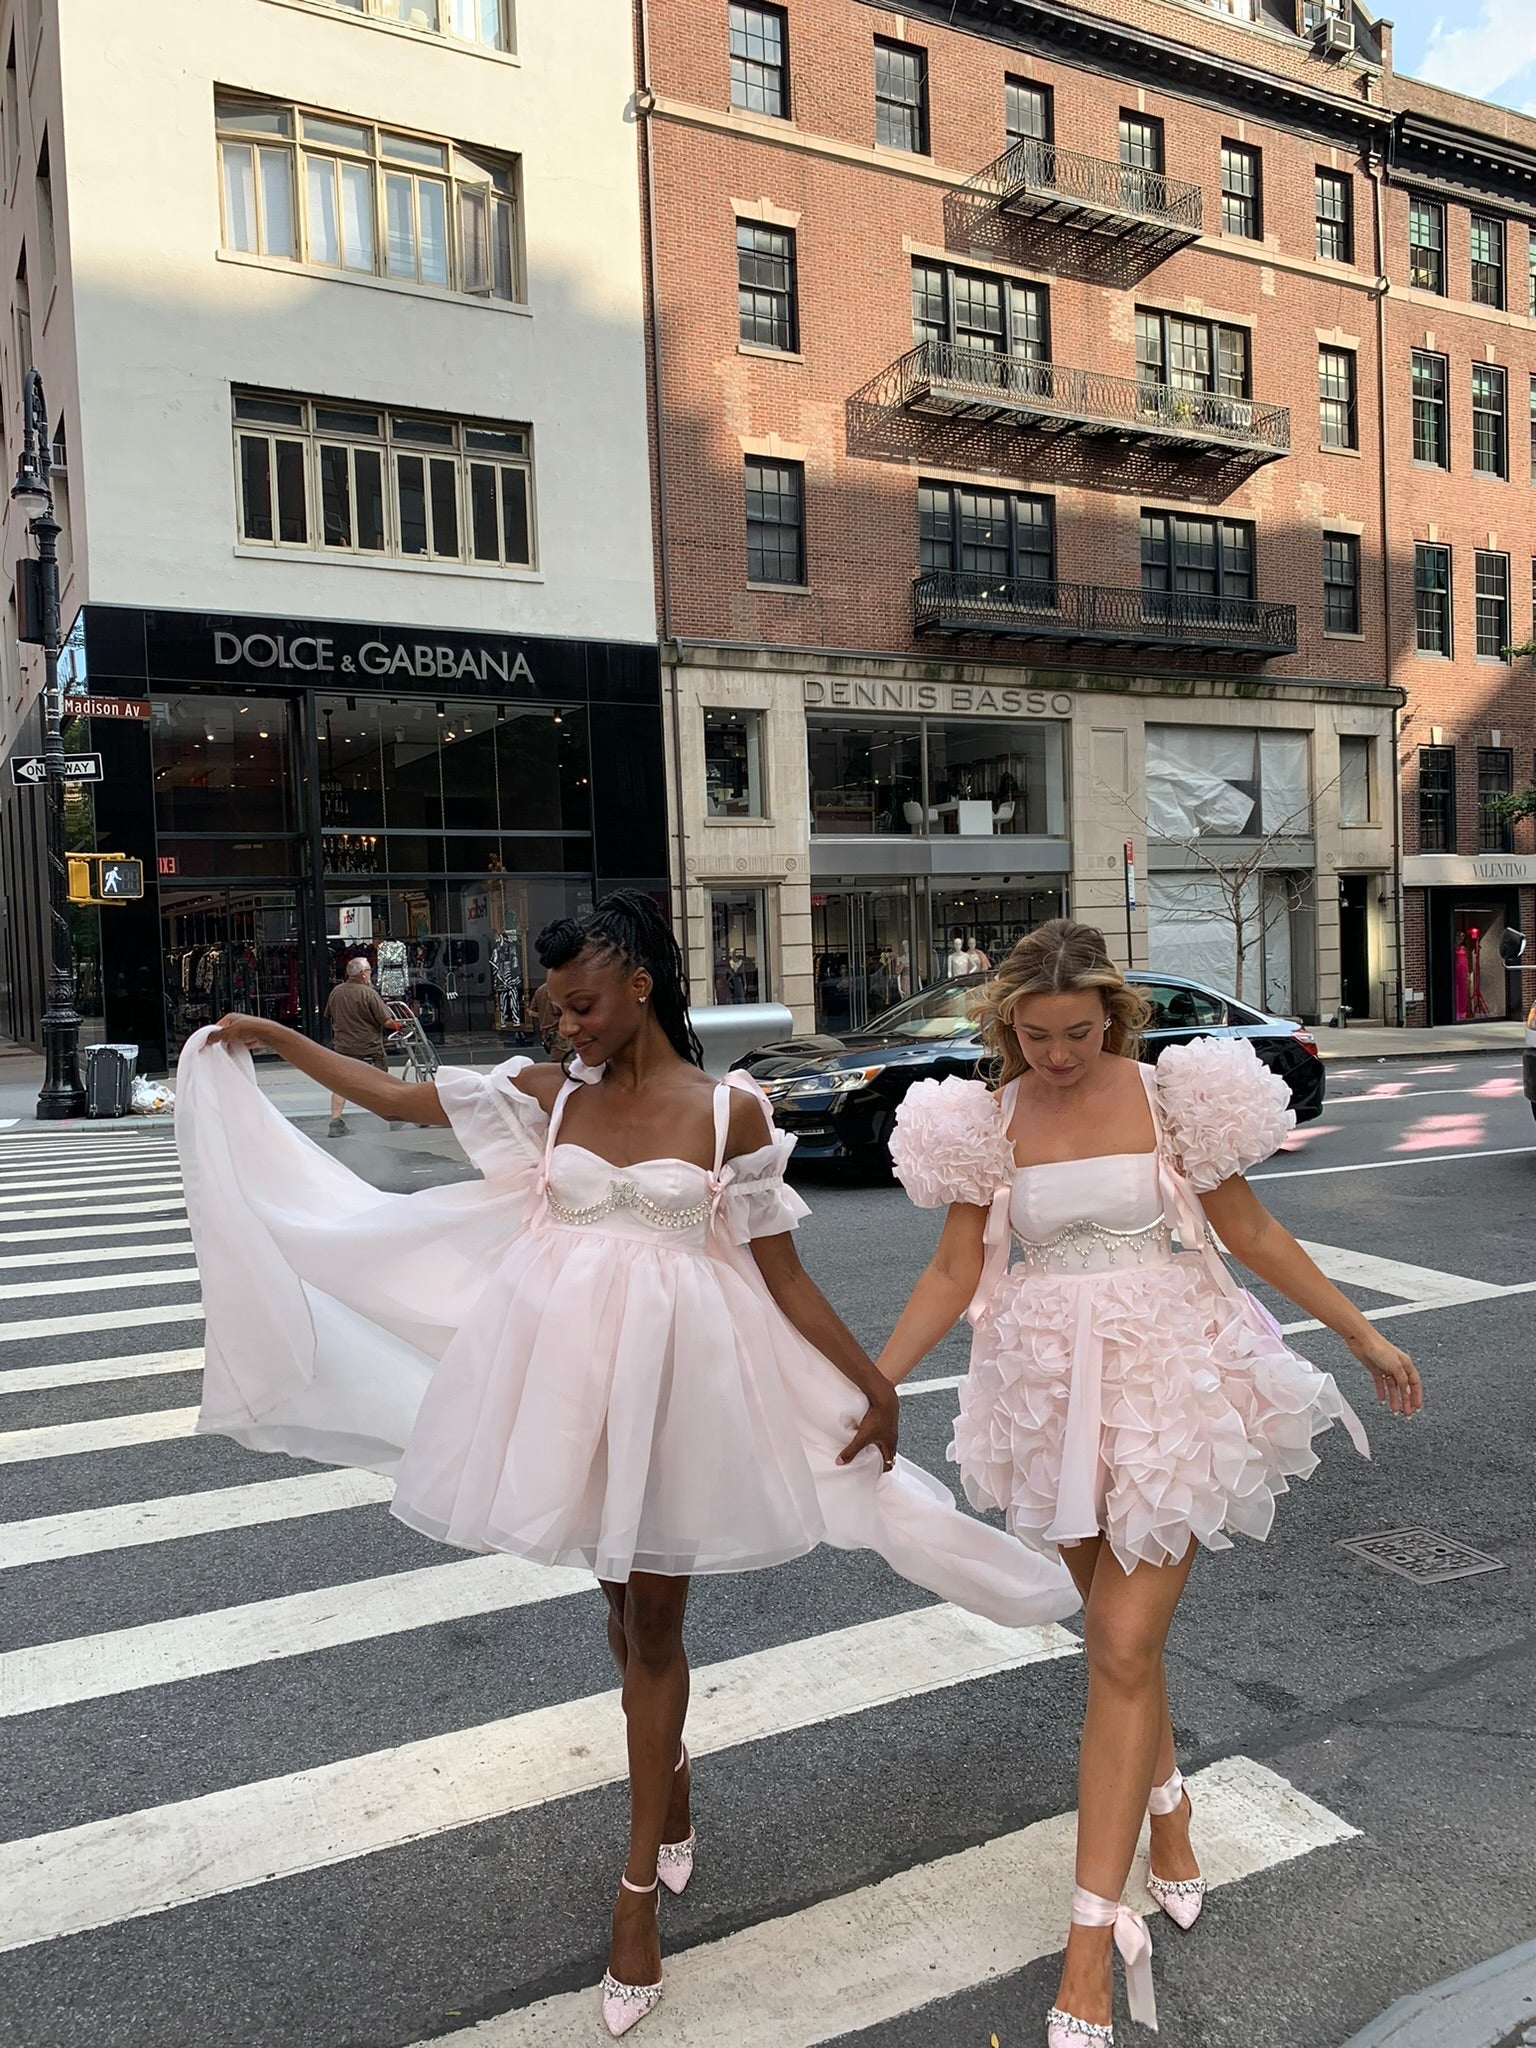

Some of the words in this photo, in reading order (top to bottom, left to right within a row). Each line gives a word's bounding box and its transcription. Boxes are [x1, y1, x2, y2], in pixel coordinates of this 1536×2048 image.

[214, 632, 335, 671] DOLCE
[341, 655, 356, 673] &
[358, 642, 535, 683] GABBANA
[803, 680, 937, 709] DENNIS
[951, 688, 1073, 715] BASSO
[64, 699, 119, 716] Madison
[125, 703, 140, 717] Av
[26, 765, 46, 776] ON
[1472, 863, 1527, 878] VALENTINO
